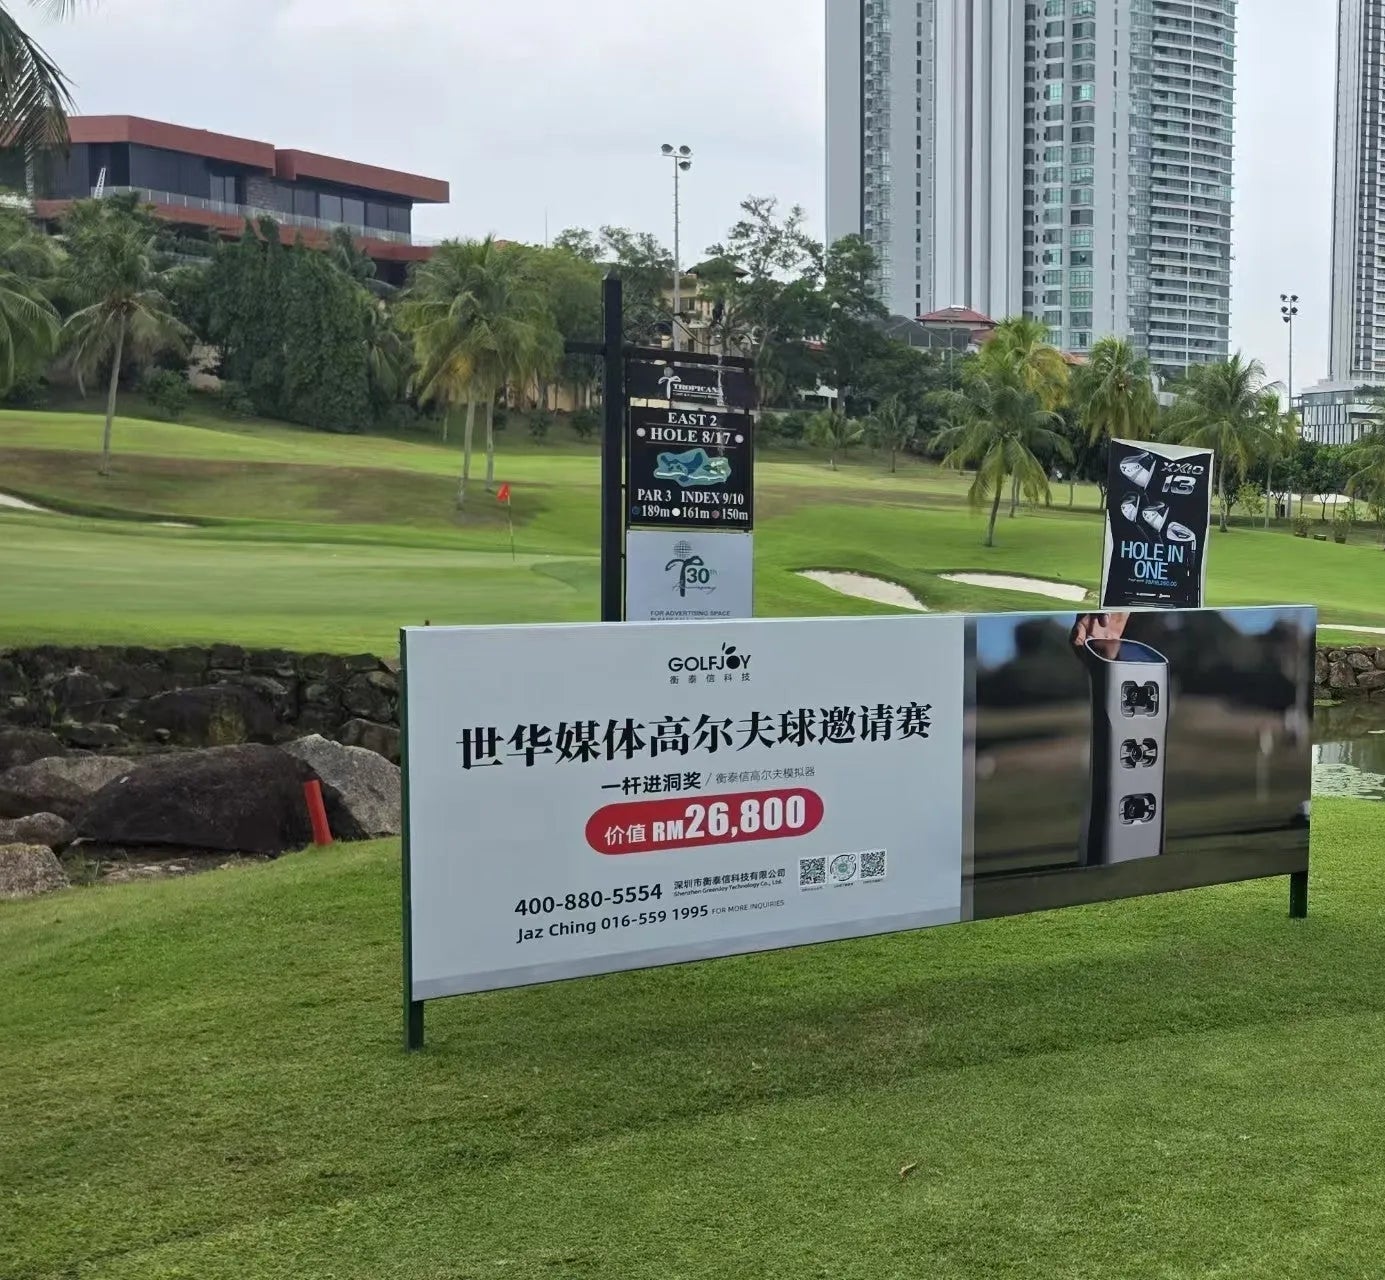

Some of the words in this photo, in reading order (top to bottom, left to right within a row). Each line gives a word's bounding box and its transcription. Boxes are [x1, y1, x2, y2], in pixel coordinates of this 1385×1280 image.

[668, 412, 706, 426] EAST
[710, 415, 717, 426] 2
[650, 427, 698, 443] HOLE
[702, 431, 731, 445] 8/17
[1161, 474, 1197, 495] 13
[637, 488, 662, 502] PAR
[665, 490, 672, 502] 3
[681, 490, 720, 504] INDEX
[723, 493, 744, 505] 9/10
[642, 505, 670, 517] 189m
[683, 506, 710, 519] 161m
[722, 508, 748, 520] 150m
[1121, 540, 1164, 562] HOLE
[1167, 545, 1184, 564] IN
[1134, 560, 1169, 580] ONE
[668, 653, 751, 673] GOLFJOY
[669, 673, 751, 685] 衡泰信科技
[456, 701, 933, 770] 世华媒体高尔夫球邀请赛
[601, 771, 701, 796] 一杆进洞奖
[716, 766, 816, 785] 衡泰信高尔夫模拟器
[604, 824, 647, 846] 价值
[652, 795, 806, 843] RM26,800
[673, 868, 786, 890] 深圳市衡泰信科技有限公司
[514, 883, 663, 916] 400-880-5554
[673, 888, 701, 898] Shenzhen
[729, 881, 759, 892] Technology
[516, 928, 543, 944] Jaz
[549, 921, 596, 937] Ching
[601, 910, 667, 929] 016-559
[672, 905, 709, 921] 1995
[728, 904, 748, 913] MORE
[750, 900, 785, 911] INQUIRIES
